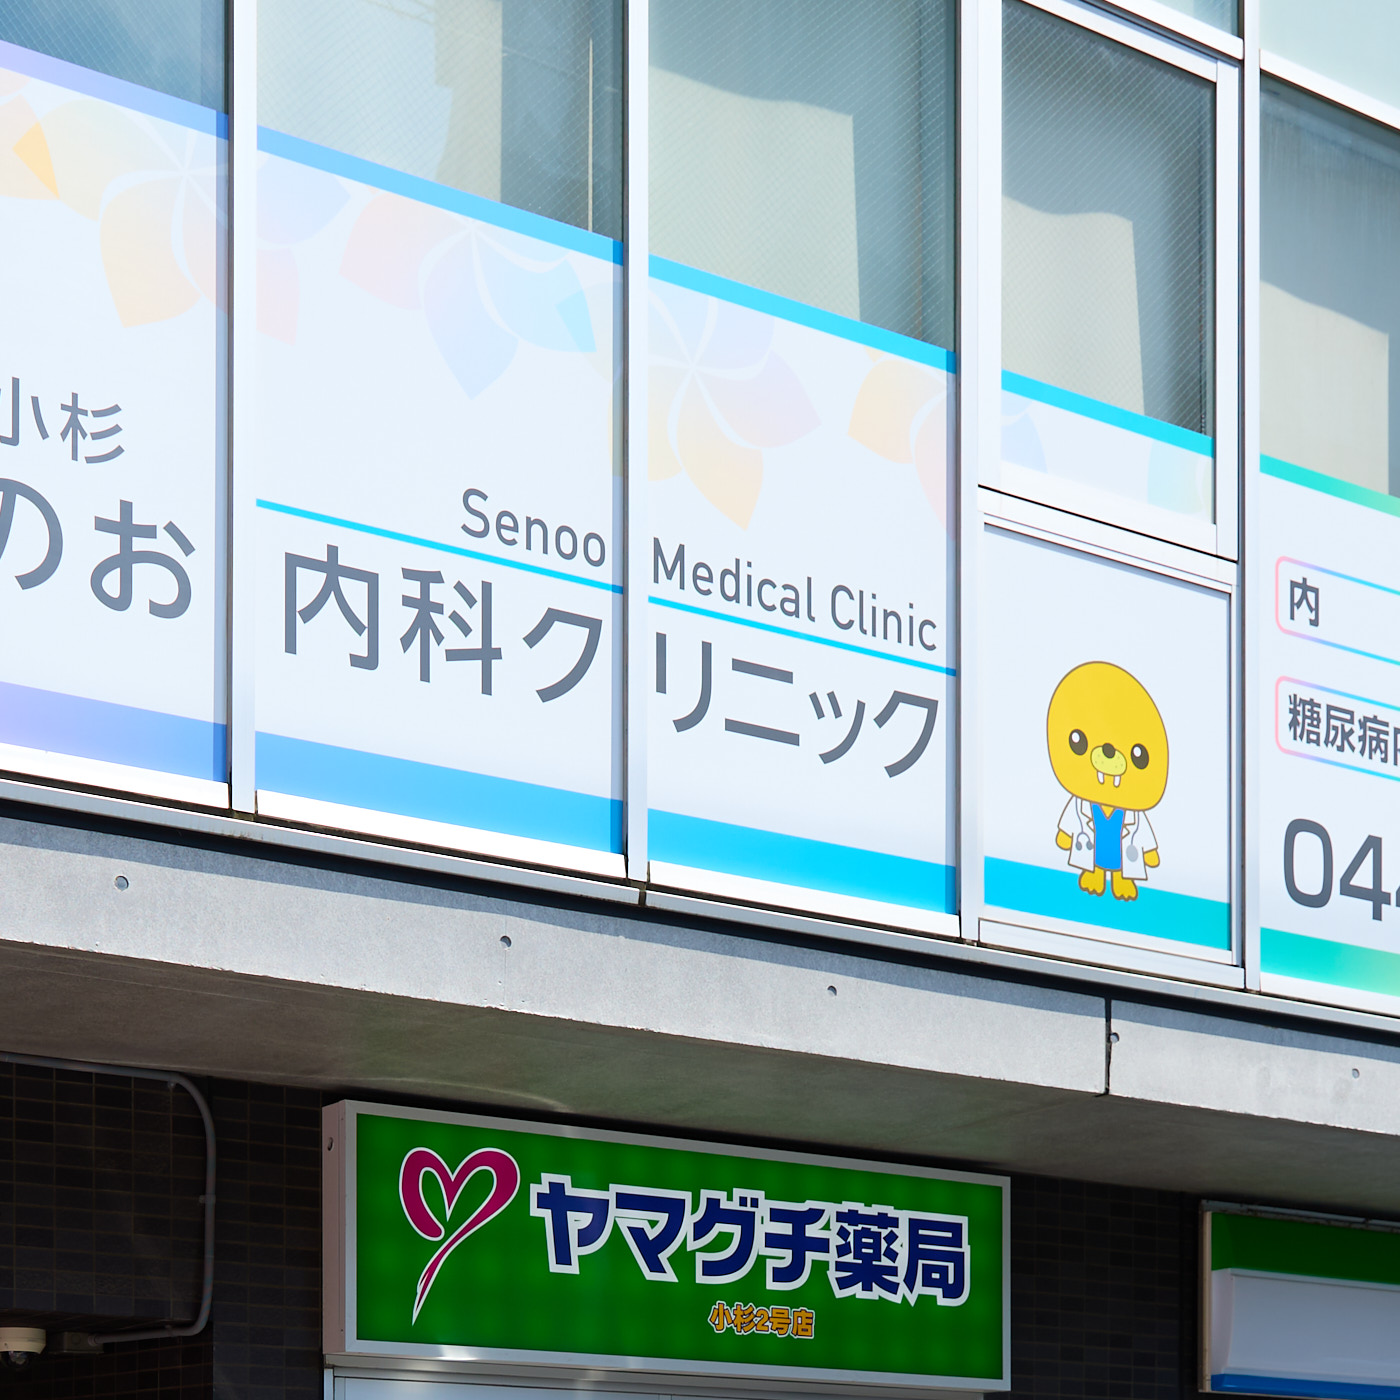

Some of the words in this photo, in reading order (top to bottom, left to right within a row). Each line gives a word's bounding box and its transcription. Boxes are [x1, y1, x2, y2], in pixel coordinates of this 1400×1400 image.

[461, 488, 607, 568] Senoo
[653, 537, 816, 624] Medical
[830, 585, 938, 652] Clinic
[530, 1172, 971, 1307] ヤマグチ薬局
[708, 1301, 815, 1339] 小杉2号店
